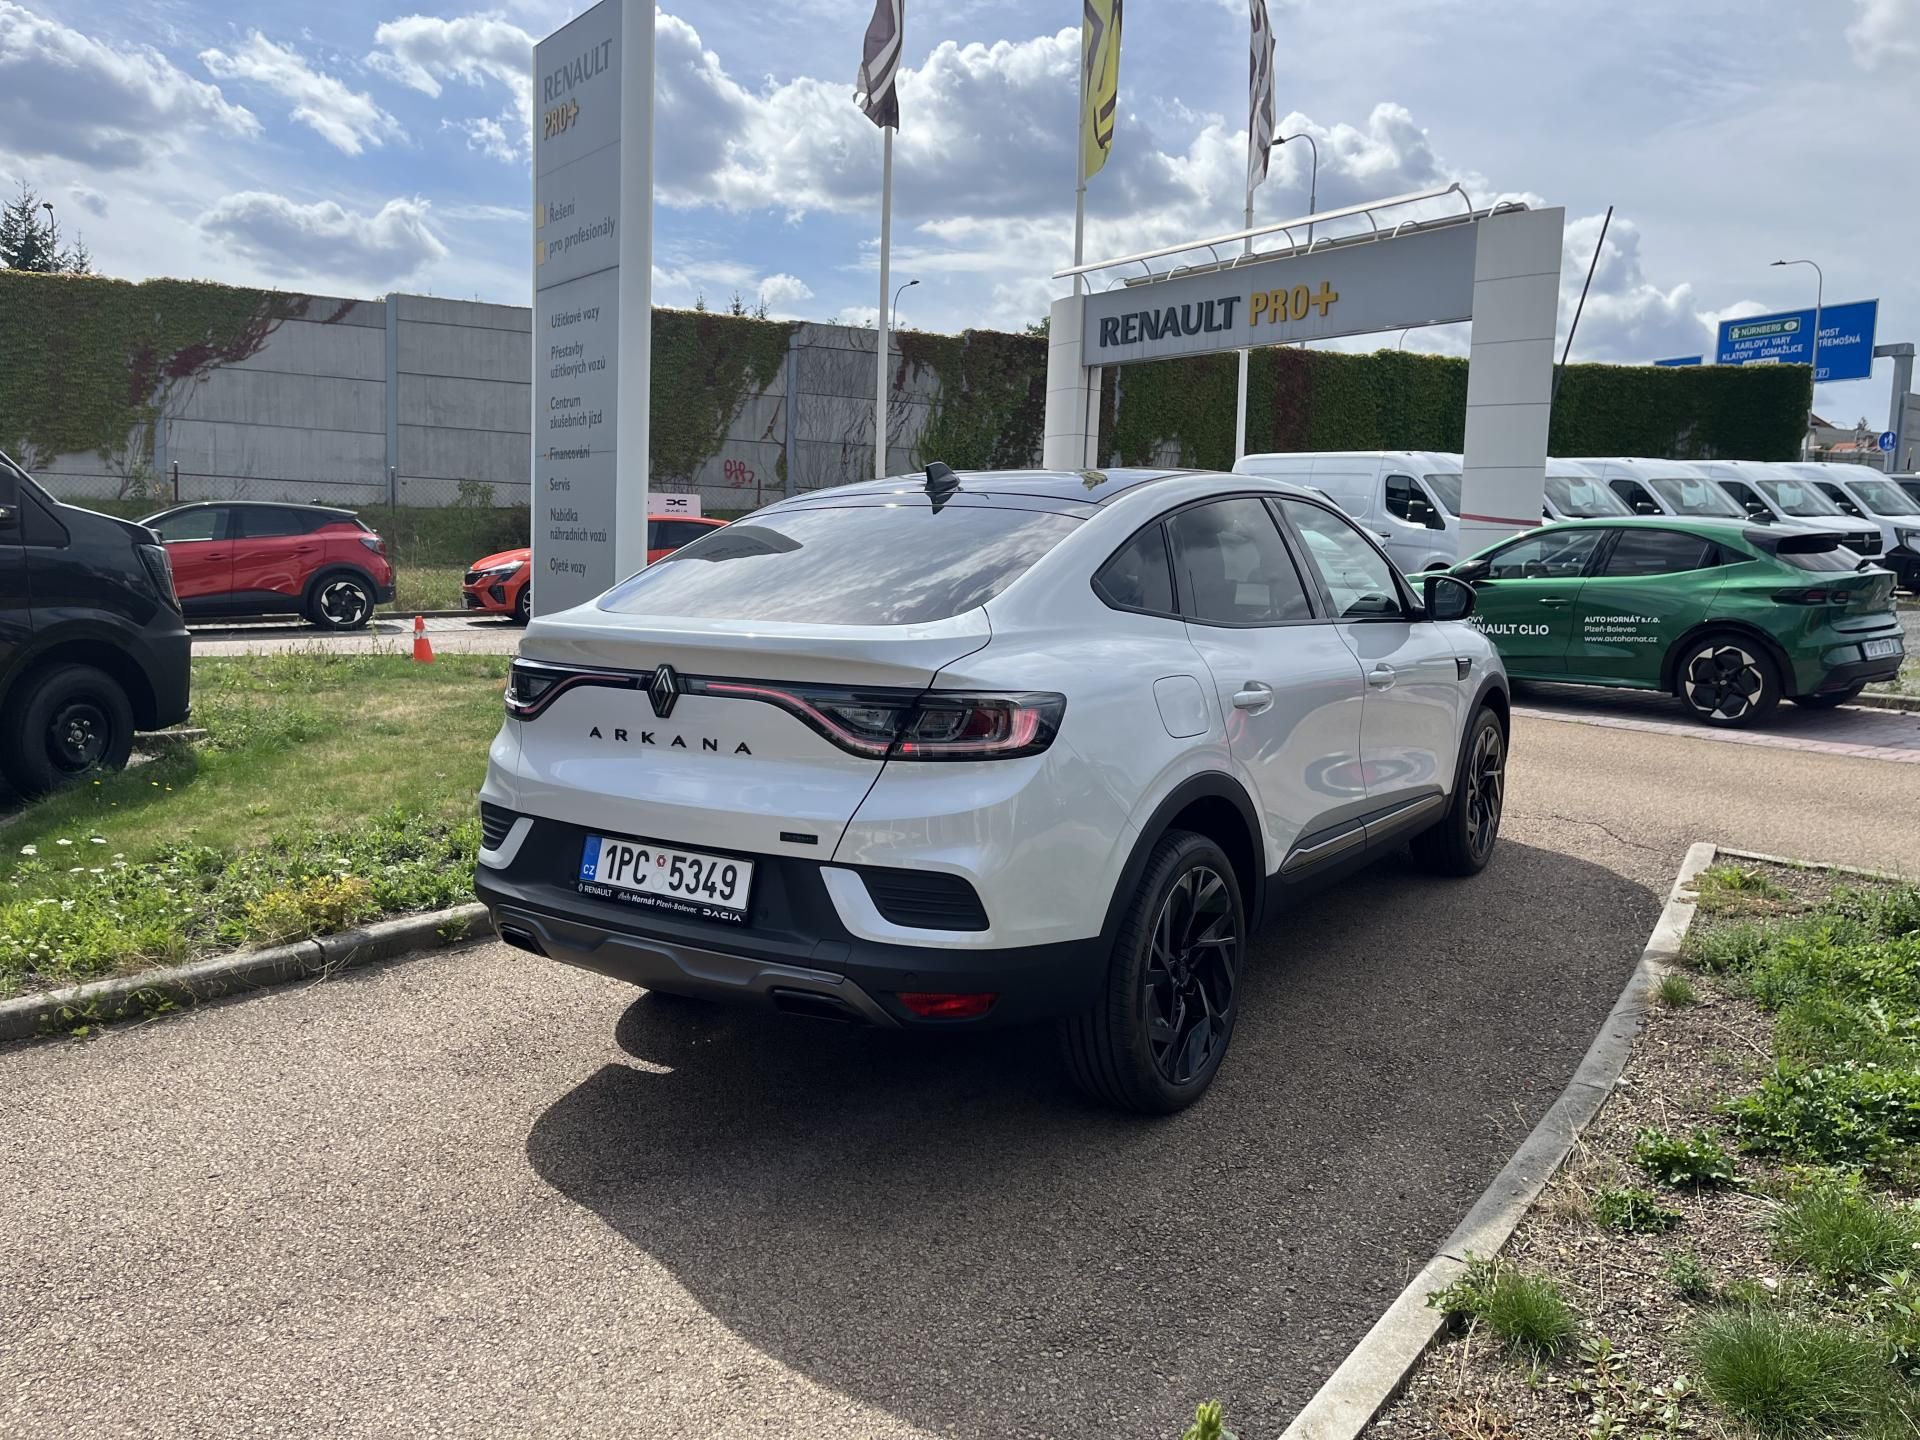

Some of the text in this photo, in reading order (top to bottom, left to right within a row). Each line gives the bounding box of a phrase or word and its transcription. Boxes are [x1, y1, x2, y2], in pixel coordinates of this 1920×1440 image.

[544, 38, 612, 104] RENAULT
[544, 98, 579, 141] PRO+
[549, 197, 575, 224] Řešení
[549, 216, 615, 260] pro profesionály
[551, 307, 599, 328] Užitkové vozy
[1100, 281, 1338, 347] RENAULT PRO+
[1818, 328, 1840, 338] MOST
[1818, 334, 1861, 347] TŘEMOŠNÁ
[551, 341, 583, 360] Přestavby
[1735, 336, 1791, 350] KARLOVY VARY
[1722, 344, 1803, 361] KLATOVY DOMAŽLICE
[550, 355, 606, 379] užitkových vozů
[550, 396, 580, 410] Centrum
[550, 409, 602, 429] zkušebních jízd
[549, 444, 590, 461] Financování
[550, 477, 570, 491] Servis
[550, 508, 578, 522] Nabídka
[550, 527, 607, 542] náhradních vozů
[550, 558, 586, 577] Ojeté vozy
[1467, 614, 1483, 623] OVÝ
[1607, 615, 1640, 623] HORNÁT
[1474, 624, 1549, 635] NAULT CLIO
[1584, 625, 1637, 633] Plzeň-Bolevec
[1584, 635, 1658, 643] www.autohornat.cz
[589, 726, 752, 755] ARKANA
[583, 864, 595, 876] CZ
[606, 845, 738, 900] 1PC 5349
[584, 885, 612, 897] RENAULT
[631, 894, 655, 906] Hornát
[656, 900, 697, 914] Plzeň-Bolevec
[702, 908, 741, 922] DACIA
